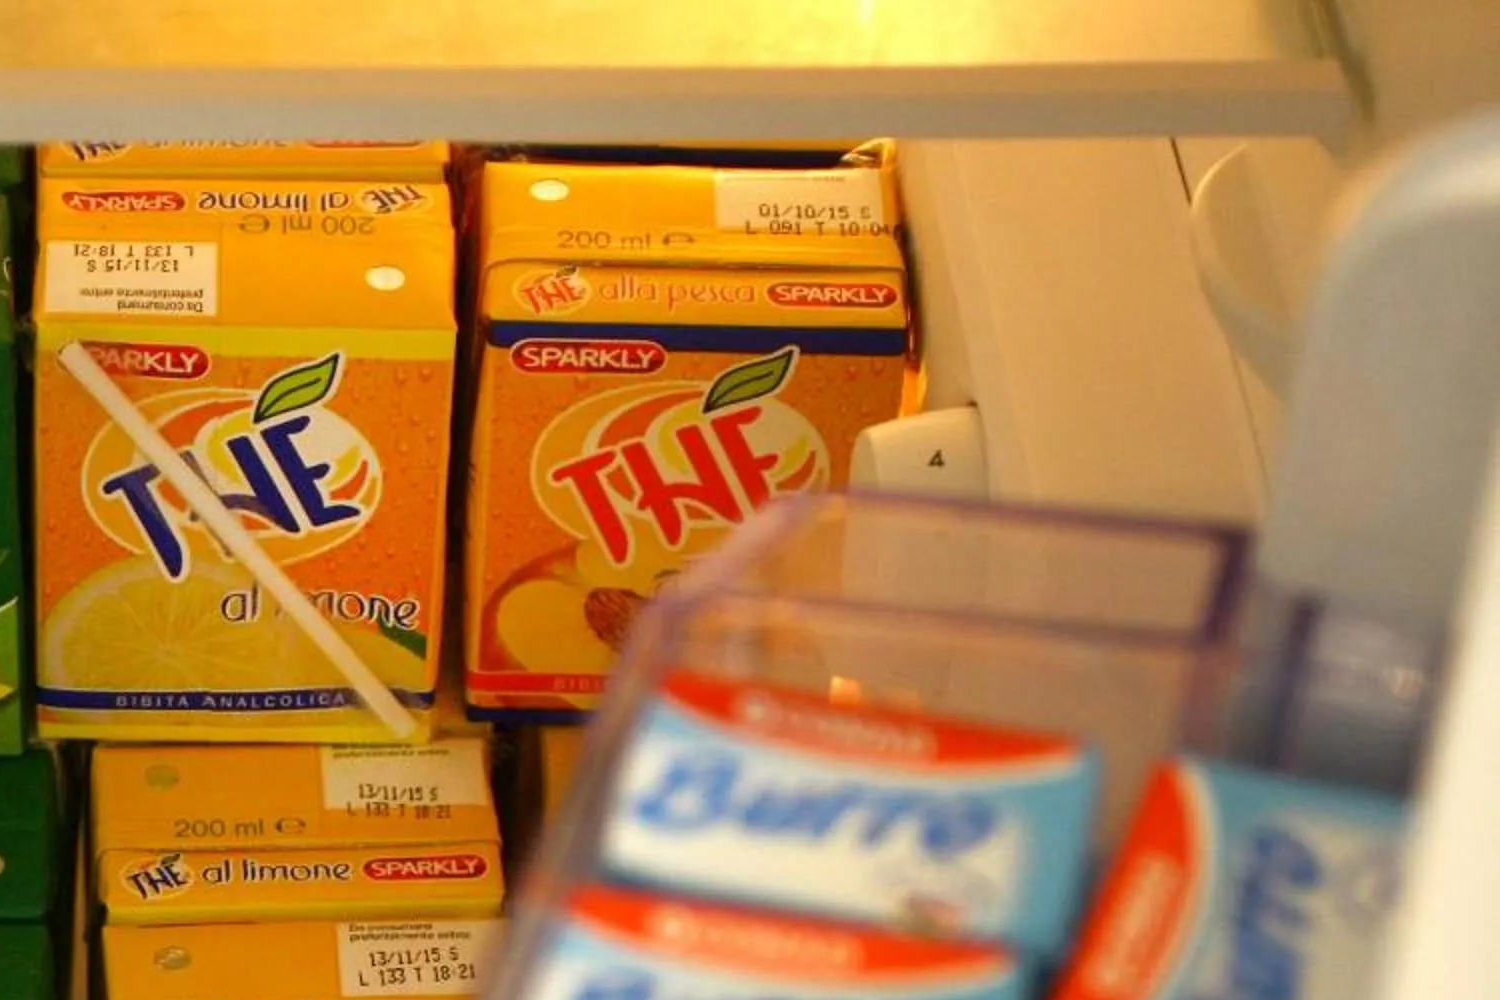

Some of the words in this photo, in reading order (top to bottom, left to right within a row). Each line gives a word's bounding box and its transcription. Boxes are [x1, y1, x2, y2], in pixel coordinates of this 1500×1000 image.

[70, 193, 177, 211] SPARKLY
[199, 192, 308, 212] limone
[321, 193, 349, 212] al
[759, 203, 849, 219] 01/10/15
[283, 215, 312, 233] ml
[322, 215, 374, 235] 200
[745, 220, 757, 234] L
[557, 230, 610, 248] 200
[620, 232, 651, 250] ml
[145, 244, 171, 257] 133
[106, 258, 179, 273] 13/11/15
[602, 274, 657, 300] alla
[668, 283, 756, 312] pesca
[775, 285, 891, 304] SPARKLY
[94, 347, 200, 372] PARKLY
[521, 346, 657, 369] SPARKLY
[928, 449, 945, 469] 4
[221, 583, 259, 622] al
[115, 695, 189, 707] BIBITA
[203, 692, 345, 708] ANALCOLICA
[637, 757, 995, 855] Burro
[175, 820, 226, 838] 200
[235, 819, 264, 835] ml
[128, 860, 188, 899] THE
[202, 860, 231, 883] al
[242, 858, 351, 881] limone
[371, 860, 479, 878] SPARKLY
[368, 947, 441, 967] 13/11/15
[358, 970, 369, 986] L
[378, 967, 406, 986] 133
[413, 967, 421, 982] T
